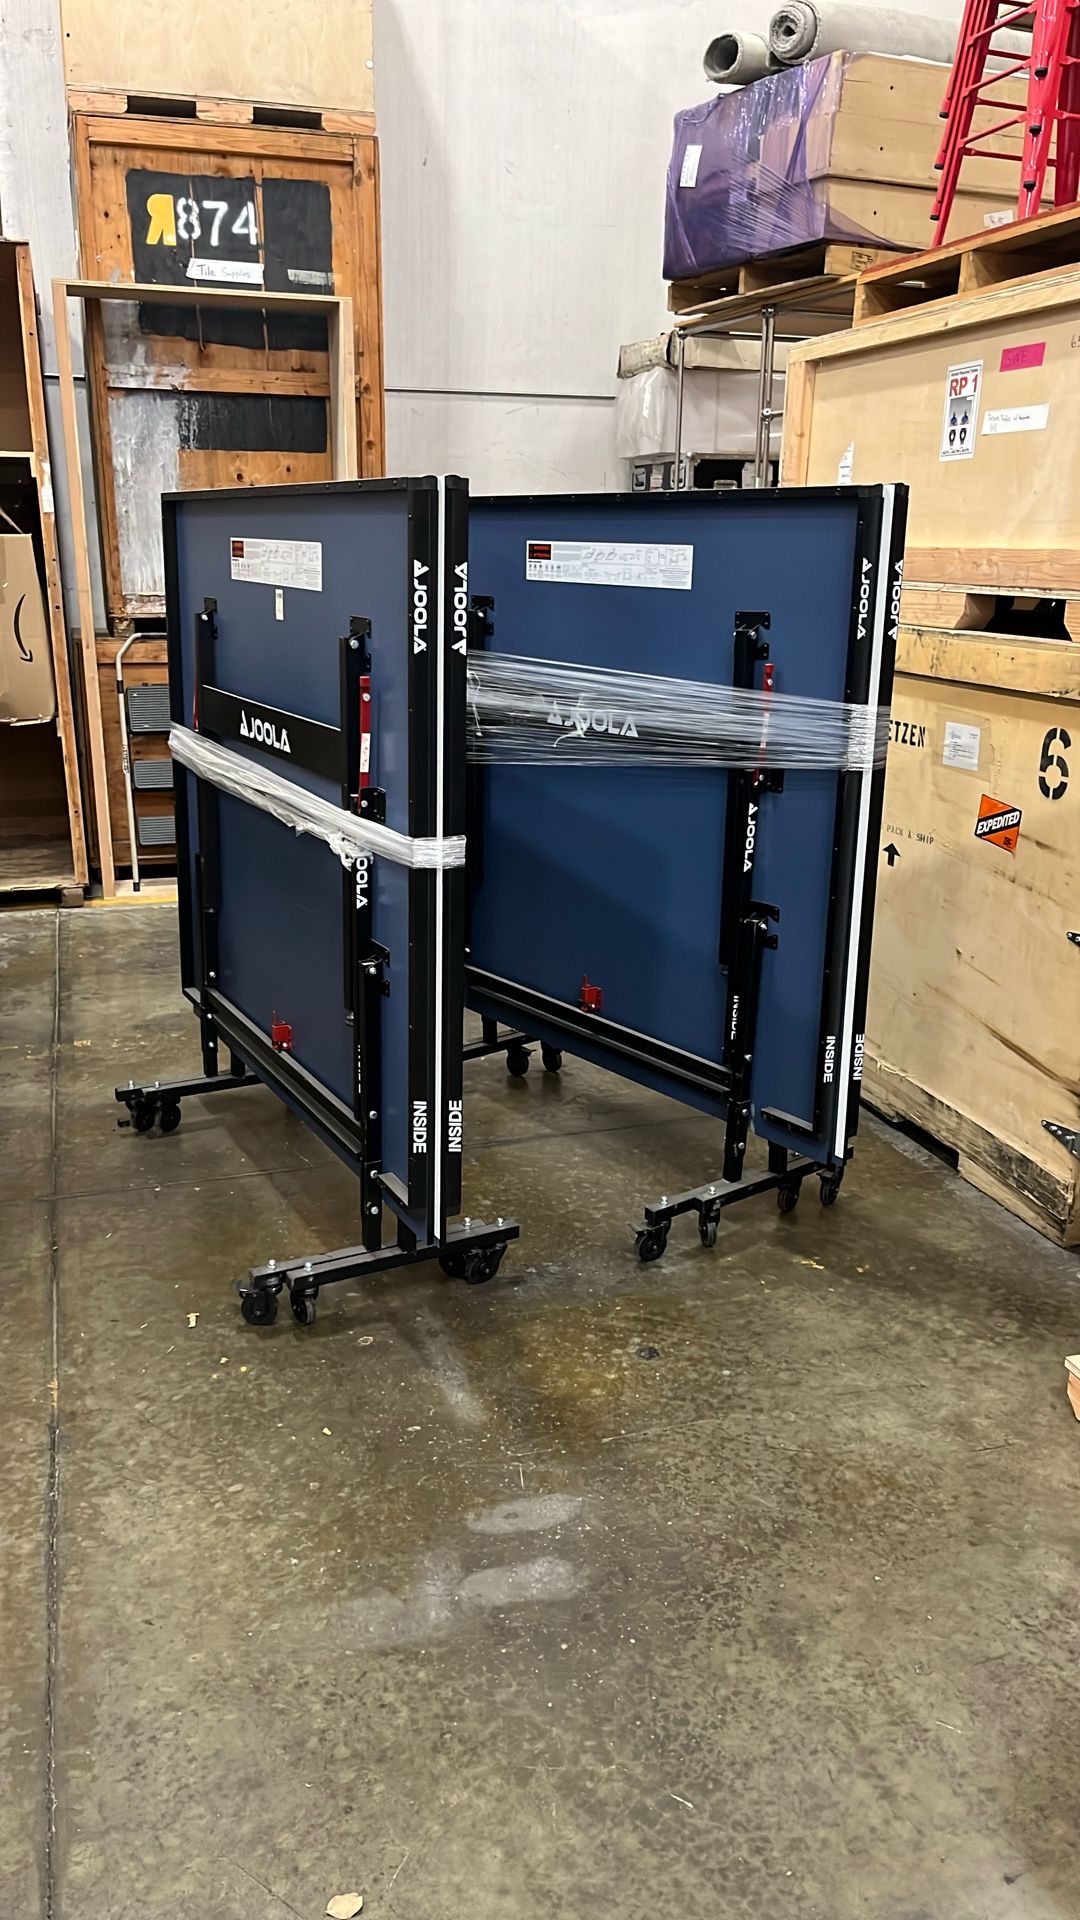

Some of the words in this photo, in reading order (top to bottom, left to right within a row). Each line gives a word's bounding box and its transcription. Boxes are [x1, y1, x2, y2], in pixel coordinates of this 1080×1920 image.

[196, 263, 216, 277] Tile
[949, 376, 968, 397] RP
[972, 374, 979, 393] 1
[413, 577, 428, 655] JOOLA
[453, 561, 468, 638] JOOLA
[857, 573, 871, 641] JOOLA
[890, 559, 904, 625] JOOLA
[249, 716, 292, 754] JOOLA
[1038, 727, 1072, 800] 6
[743, 816, 756, 873] JOOLA
[916, 833, 935, 845] SHIP
[976, 810, 1021, 835] EXPEDITED
[356, 857, 368, 910] OOLA
[823, 1035, 836, 1083] INSIDE
[853, 1033, 865, 1081] INSIDE
[412, 1100, 428, 1154] INSIDE
[448, 1099, 463, 1153] INSIDE
